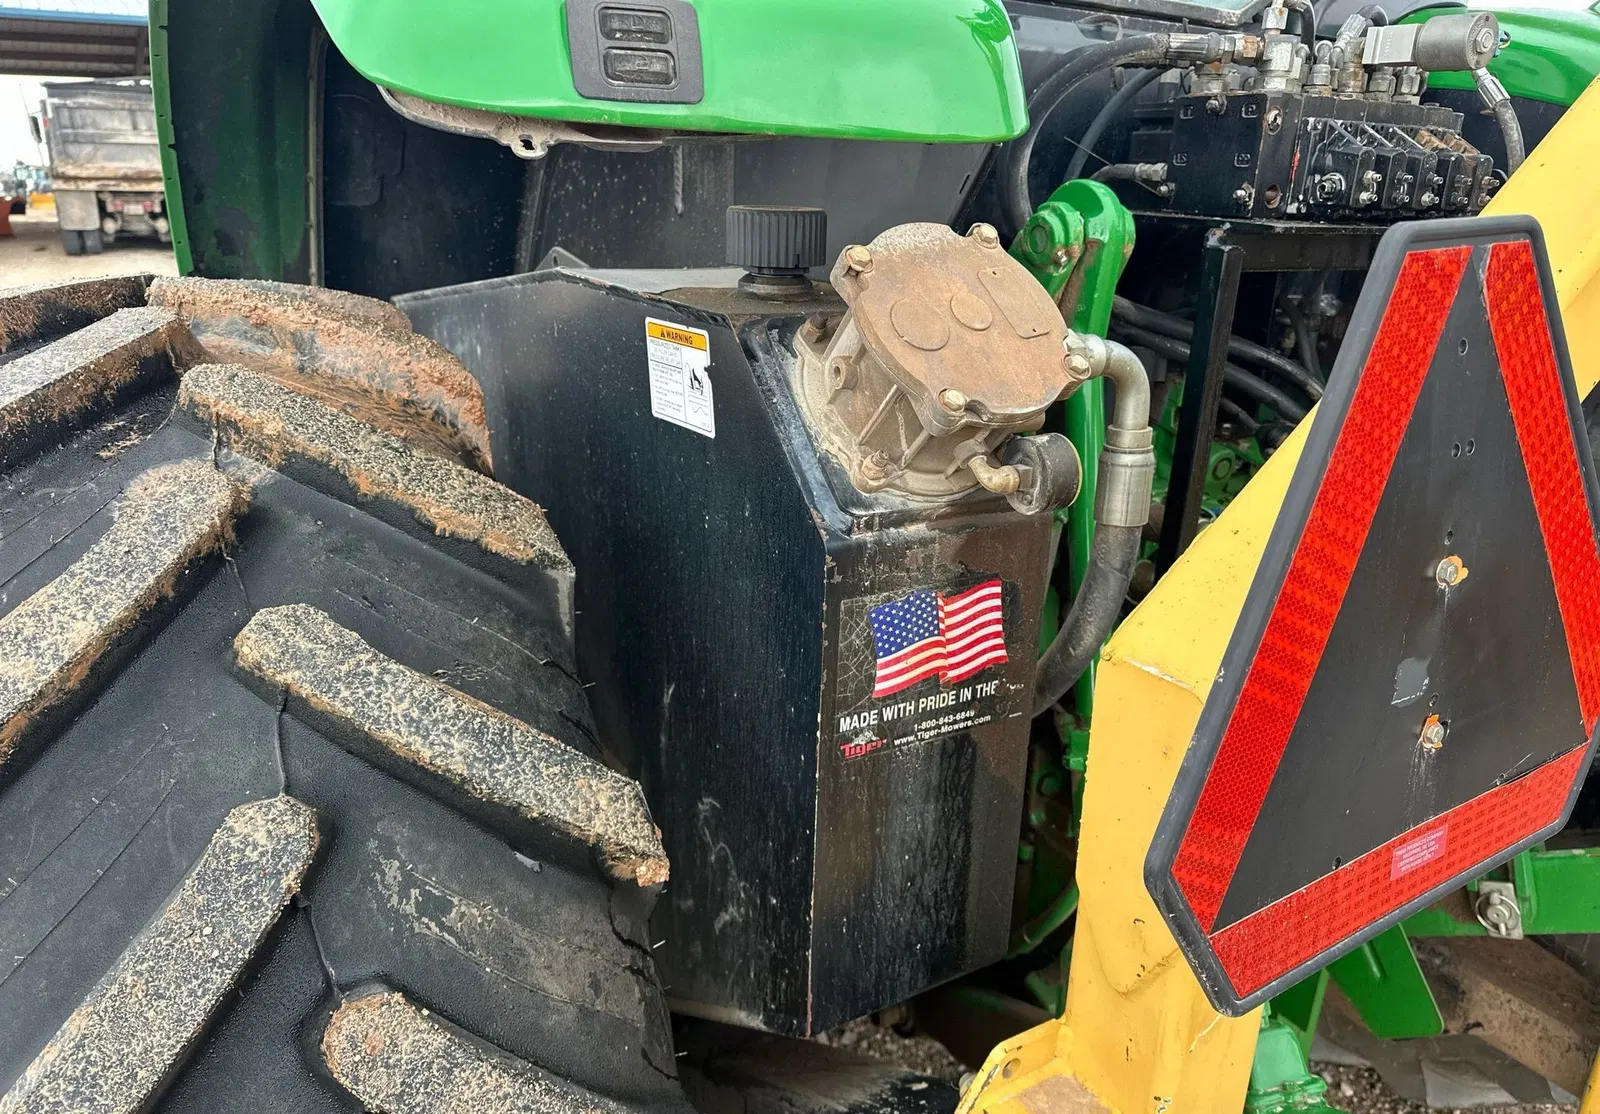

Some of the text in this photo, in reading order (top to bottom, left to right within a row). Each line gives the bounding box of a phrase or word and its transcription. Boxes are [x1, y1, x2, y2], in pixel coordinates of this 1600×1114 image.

[667, 330, 693, 345] WARNING
[839, 710, 878, 732] MADE
[882, 701, 915, 721] WITH
[918, 691, 956, 712] PRIDE
[959, 687, 972, 702] IN
[975, 680, 999, 698] THE
[893, 714, 991, 746] www.Tiger-Mowers.com
[913, 709, 976, 732] 1-800-843-6849
